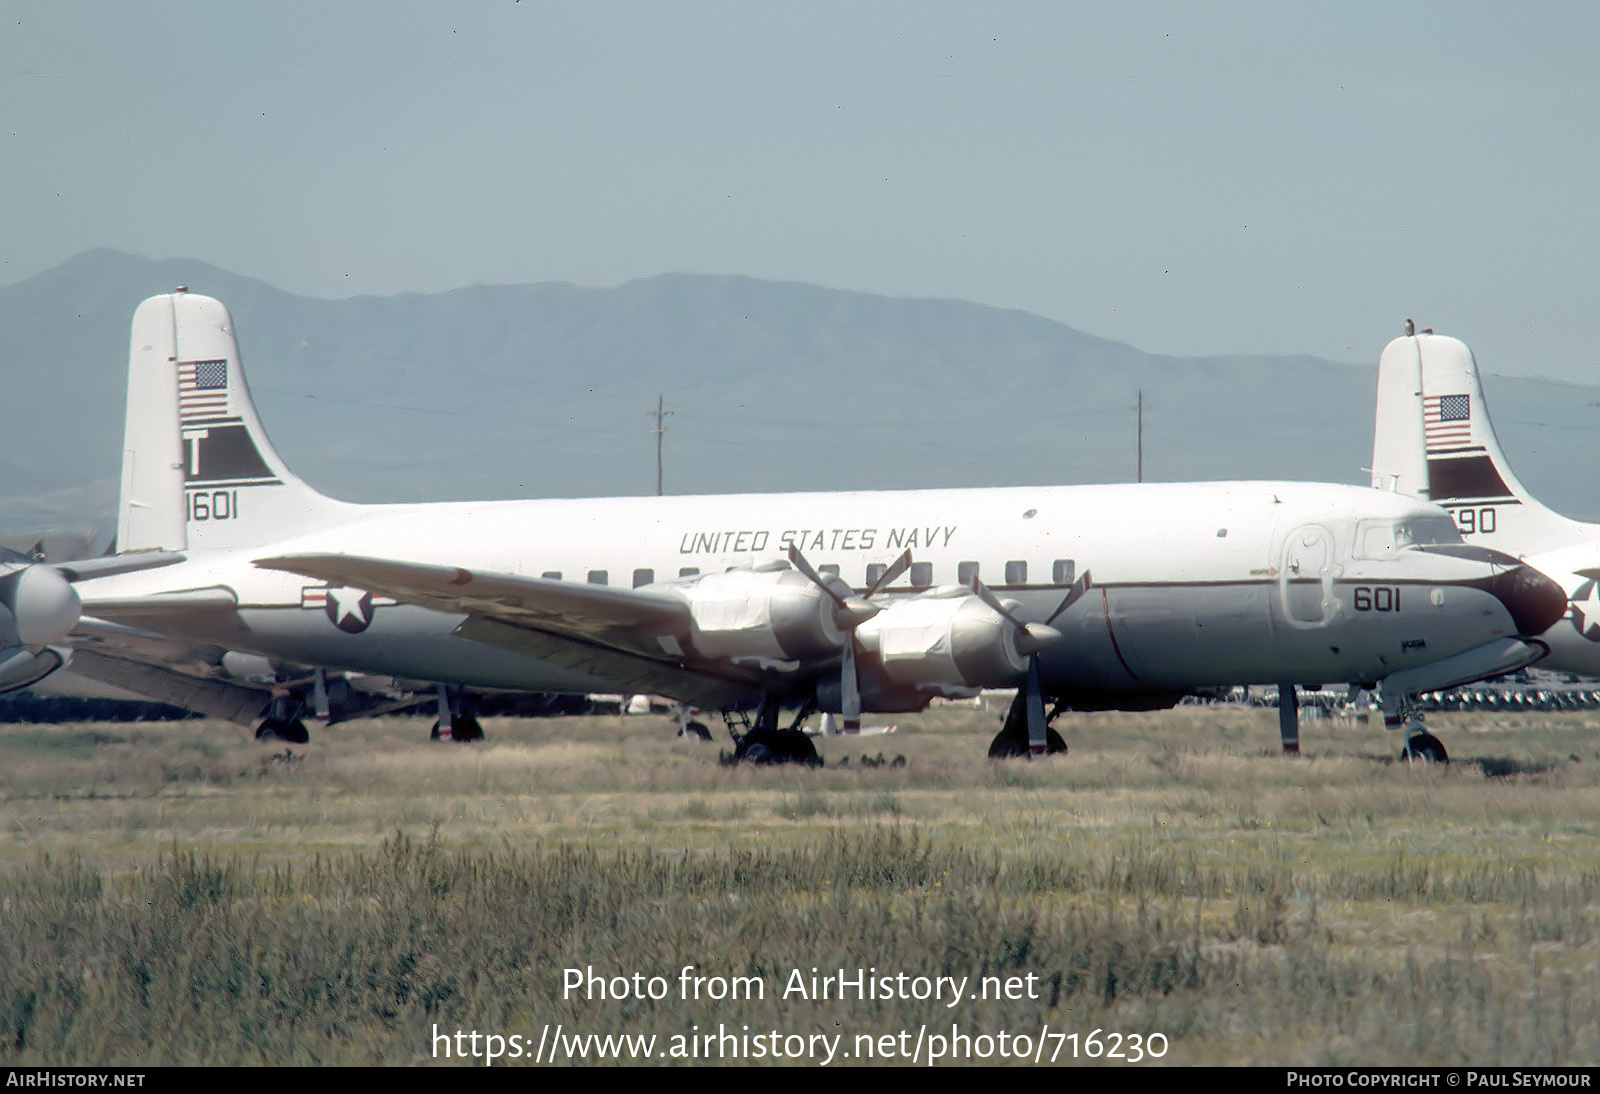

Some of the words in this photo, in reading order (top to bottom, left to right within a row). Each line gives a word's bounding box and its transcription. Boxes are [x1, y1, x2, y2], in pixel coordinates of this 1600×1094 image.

[182, 429, 208, 475] T
[185, 490, 238, 521] 1601
[1447, 507, 1496, 534] 90
[679, 530, 770, 554] UNITED
[779, 528, 878, 551] STATES
[886, 525, 958, 549] NAVY
[1353, 586, 1401, 613] 601
